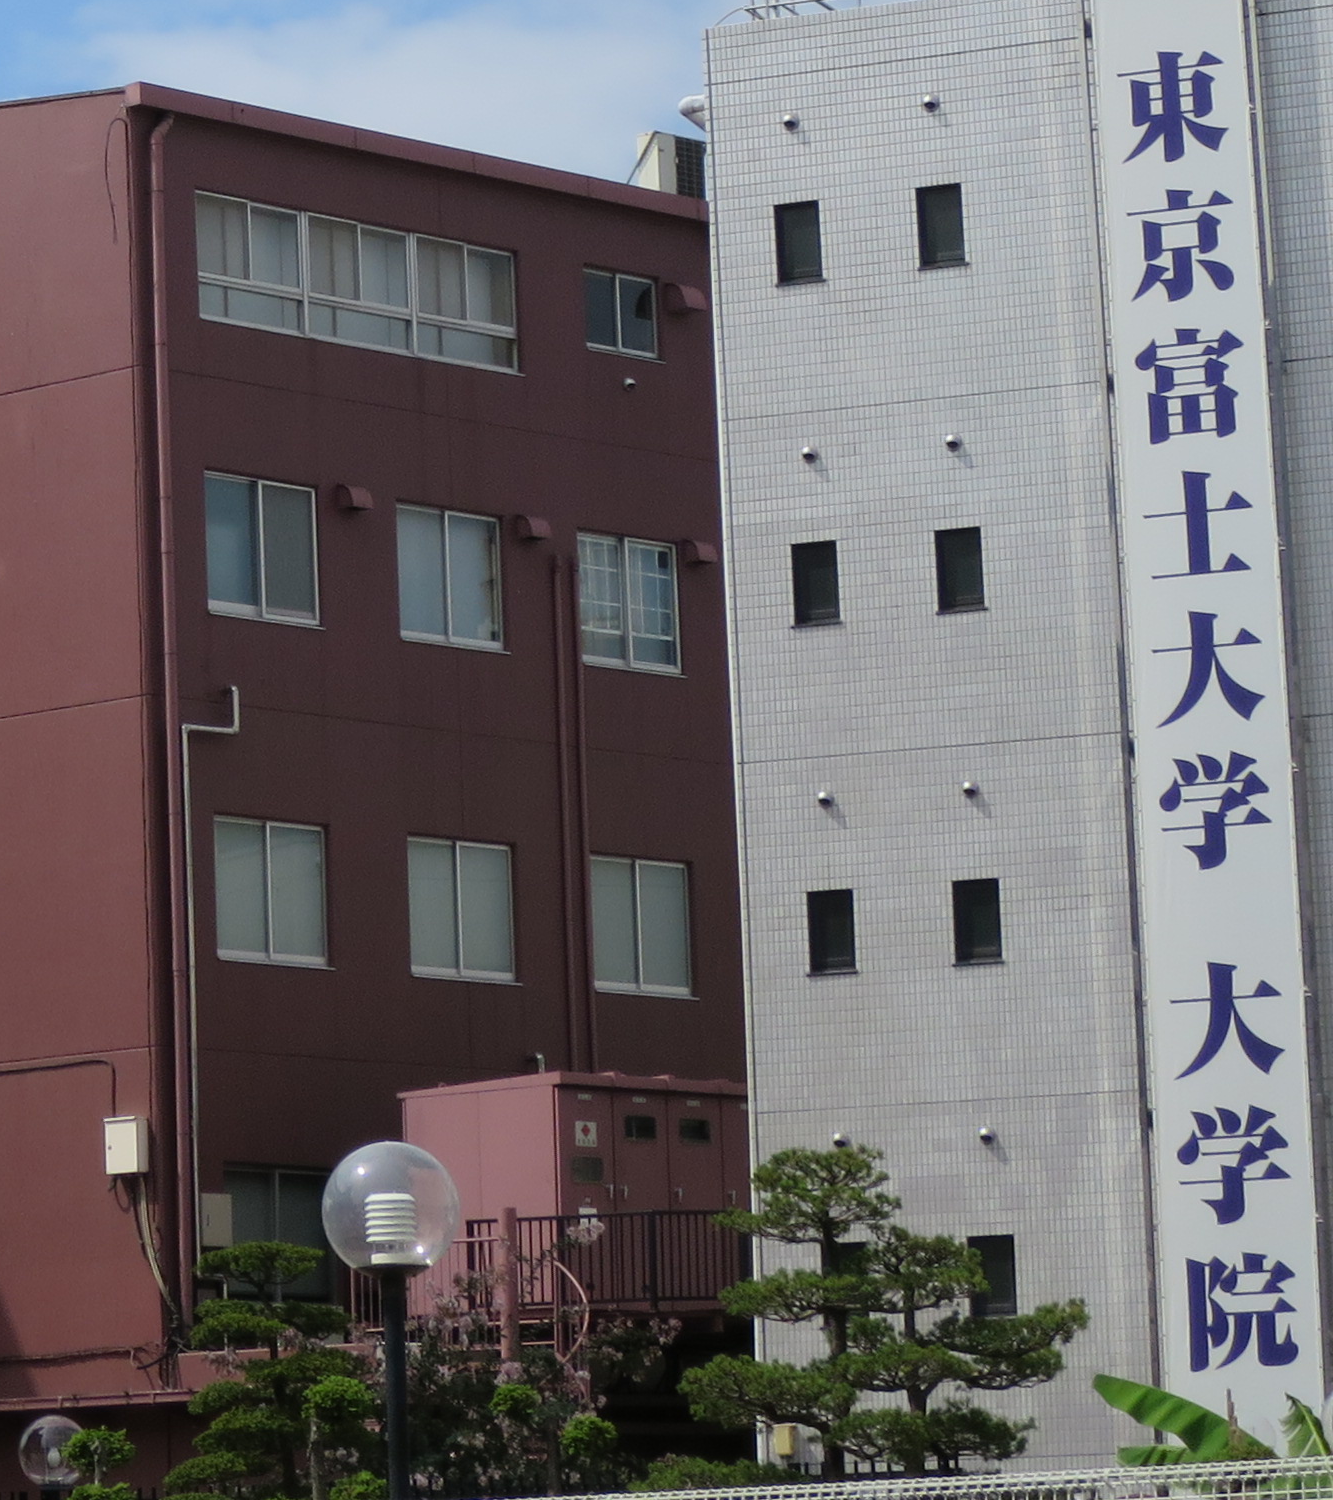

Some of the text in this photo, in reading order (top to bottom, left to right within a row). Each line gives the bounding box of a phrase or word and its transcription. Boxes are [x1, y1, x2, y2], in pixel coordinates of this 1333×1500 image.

[1117, 50, 1299, 1373] 東京富士大学 大学院
